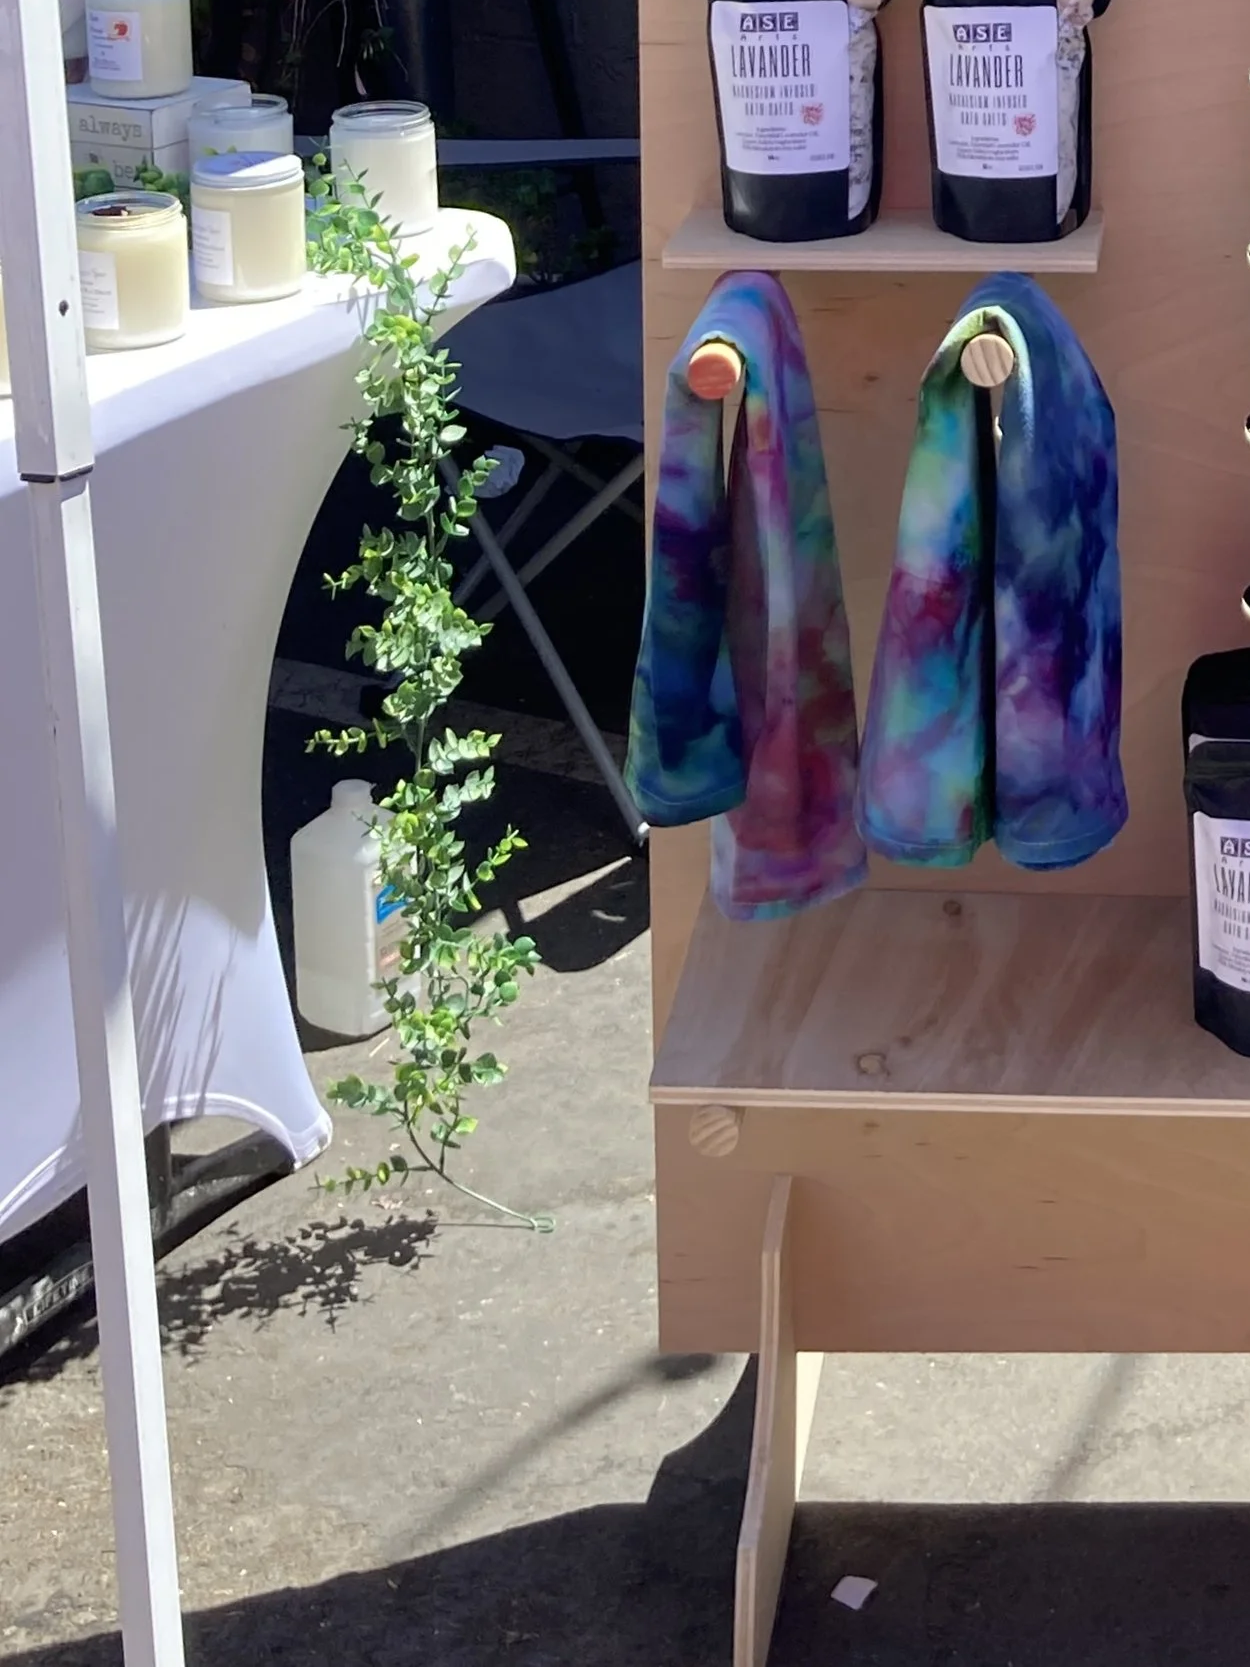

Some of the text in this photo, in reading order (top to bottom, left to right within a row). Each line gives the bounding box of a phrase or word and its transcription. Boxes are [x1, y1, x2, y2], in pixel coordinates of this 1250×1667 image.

[731, 43, 811, 78] LAVANDER
[950, 53, 1023, 88] LAVANDER
[79, 114, 142, 141] always
